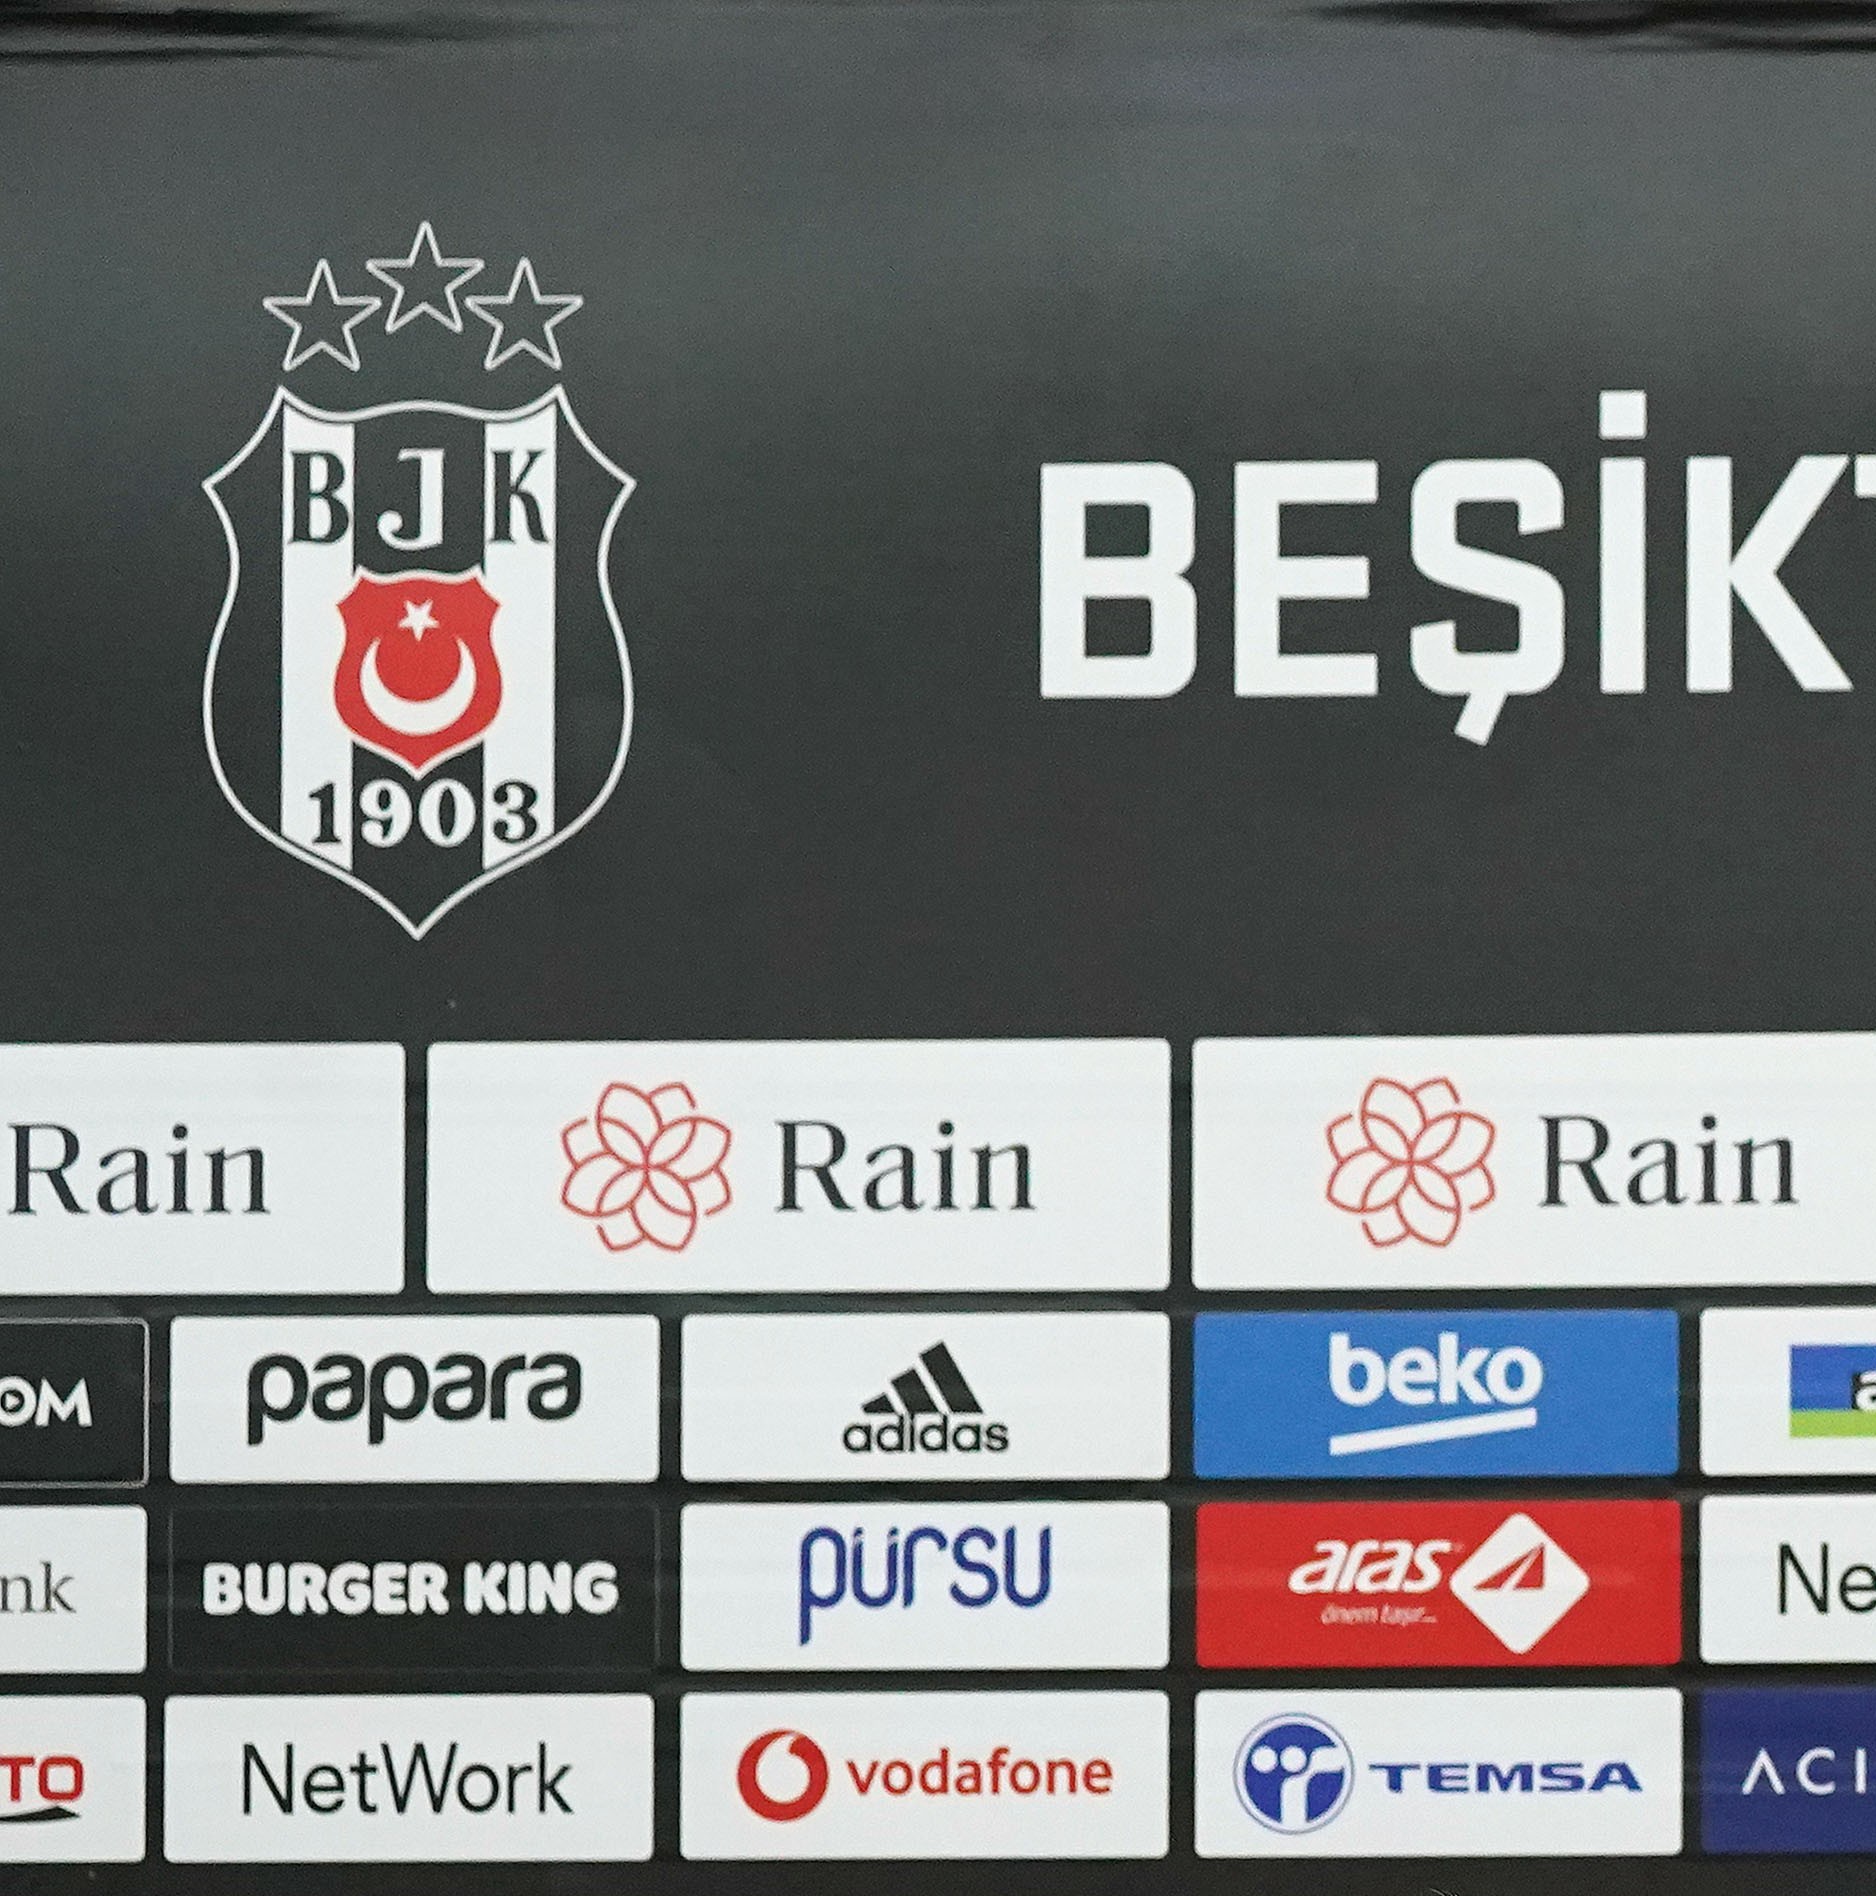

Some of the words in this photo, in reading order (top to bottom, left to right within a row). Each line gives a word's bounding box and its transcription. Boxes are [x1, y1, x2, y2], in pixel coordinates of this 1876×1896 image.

[300, 776, 548, 852] 1903
[9, 1123, 268, 1215] Rain
[778, 1120, 1034, 1212] Rain
[1541, 1115, 1796, 1207] Rain
[247, 1352, 582, 1447] papara
[1329, 1332, 1544, 1413] beko
[842, 1413, 1009, 1454] adidas
[202, 1561, 450, 1616] BURGER
[464, 1560, 619, 1615] KING
[1285, 1536, 1455, 1596] aras
[243, 1742, 573, 1815] NetWork
[846, 1746, 1113, 1796] vodafone
[1368, 1762, 1643, 1794] TEMSA
